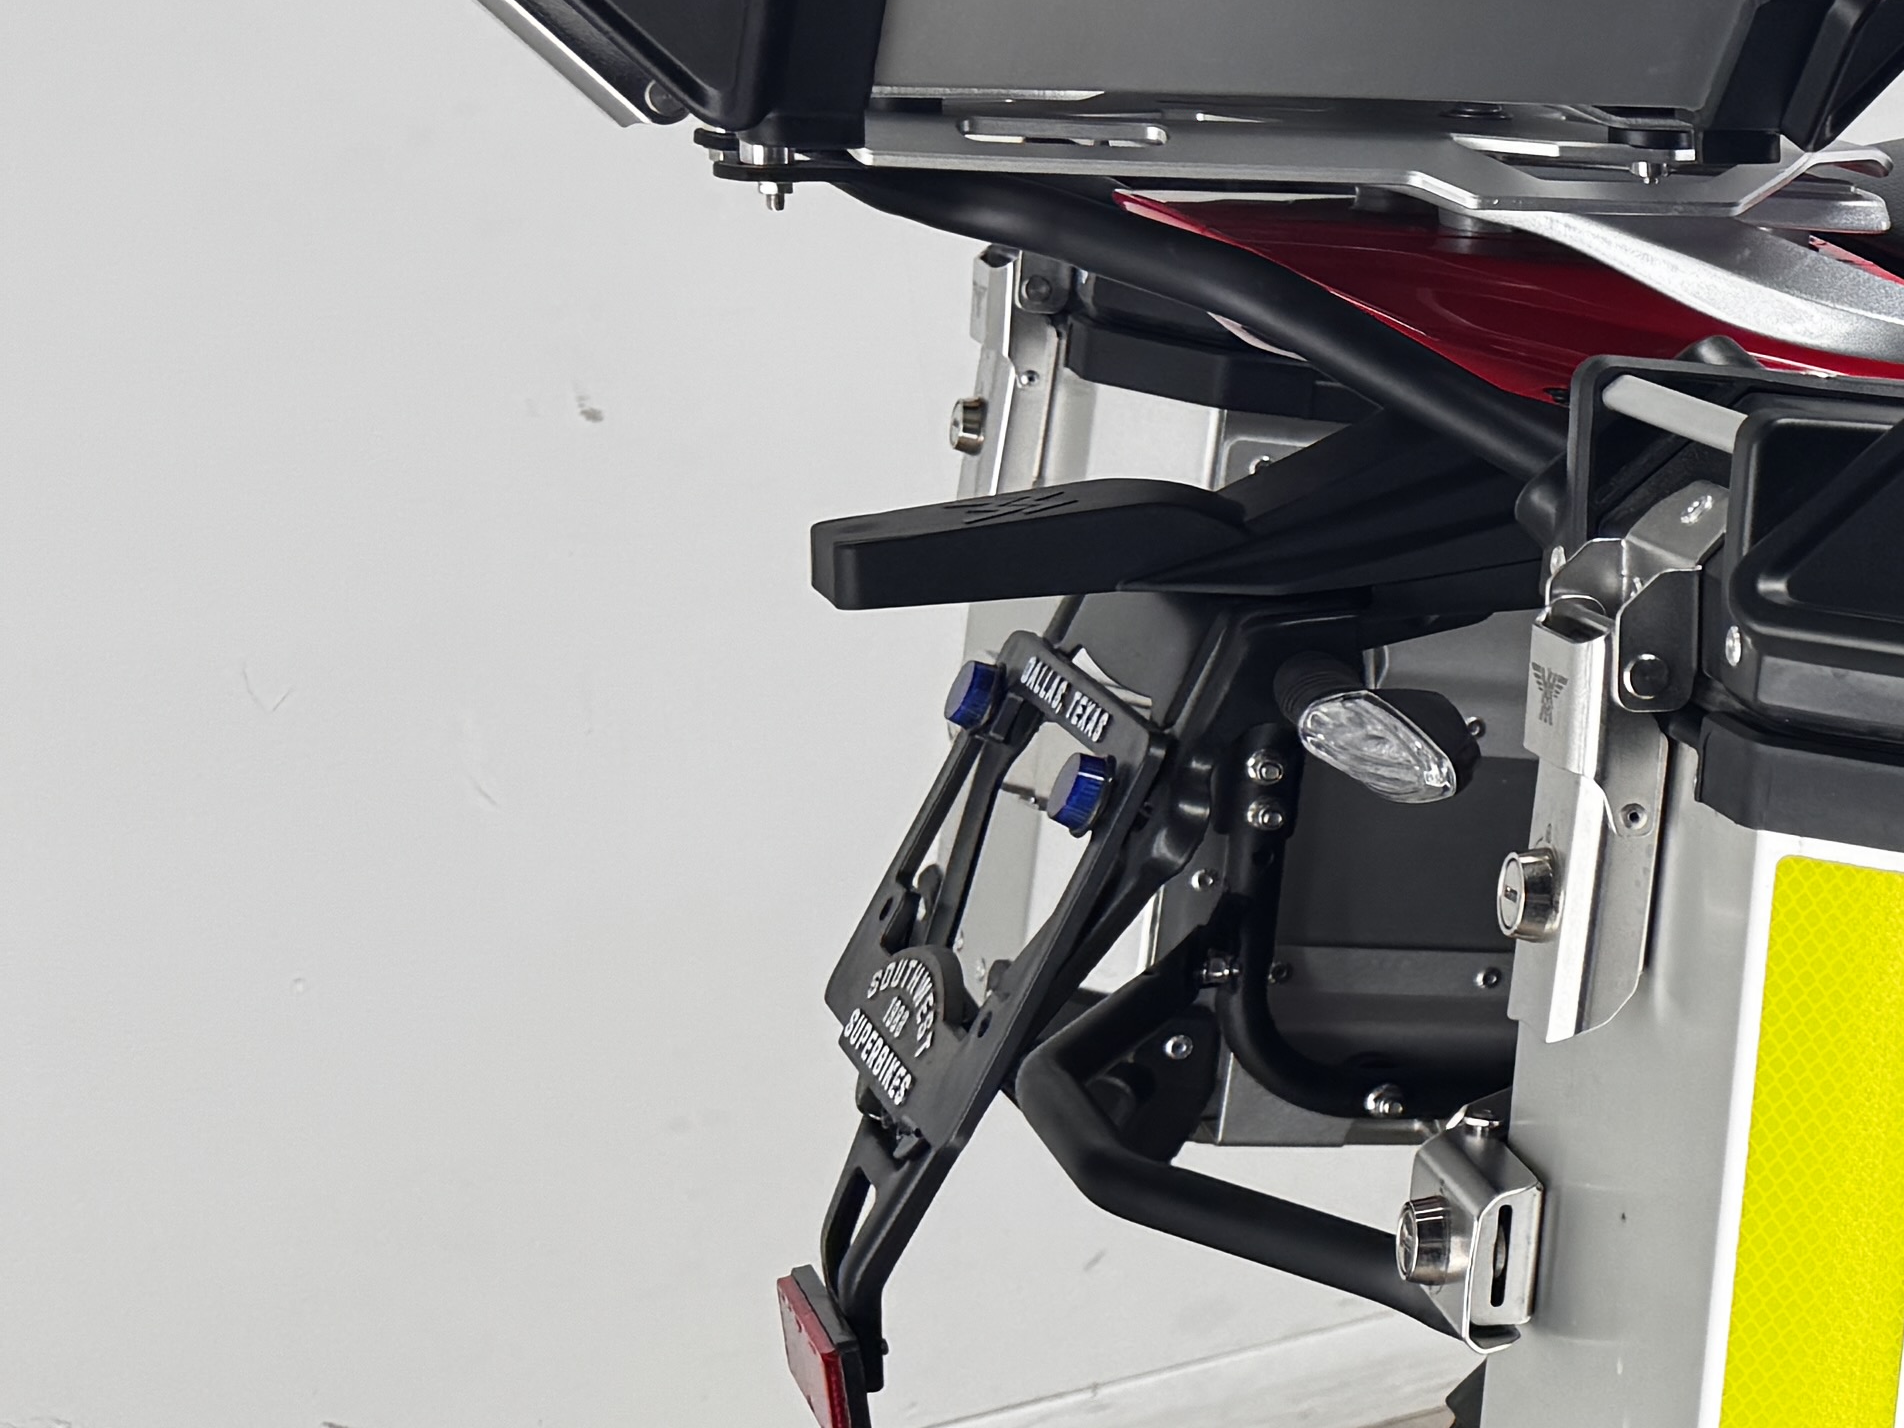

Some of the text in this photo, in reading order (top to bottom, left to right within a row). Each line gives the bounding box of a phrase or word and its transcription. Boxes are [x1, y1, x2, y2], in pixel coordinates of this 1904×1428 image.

[1020, 656, 1110, 744] DALLAS, TEXAS
[843, 1007, 913, 1106] SUPERBIKES
[866, 958, 936, 1059] SOUTHWEST
